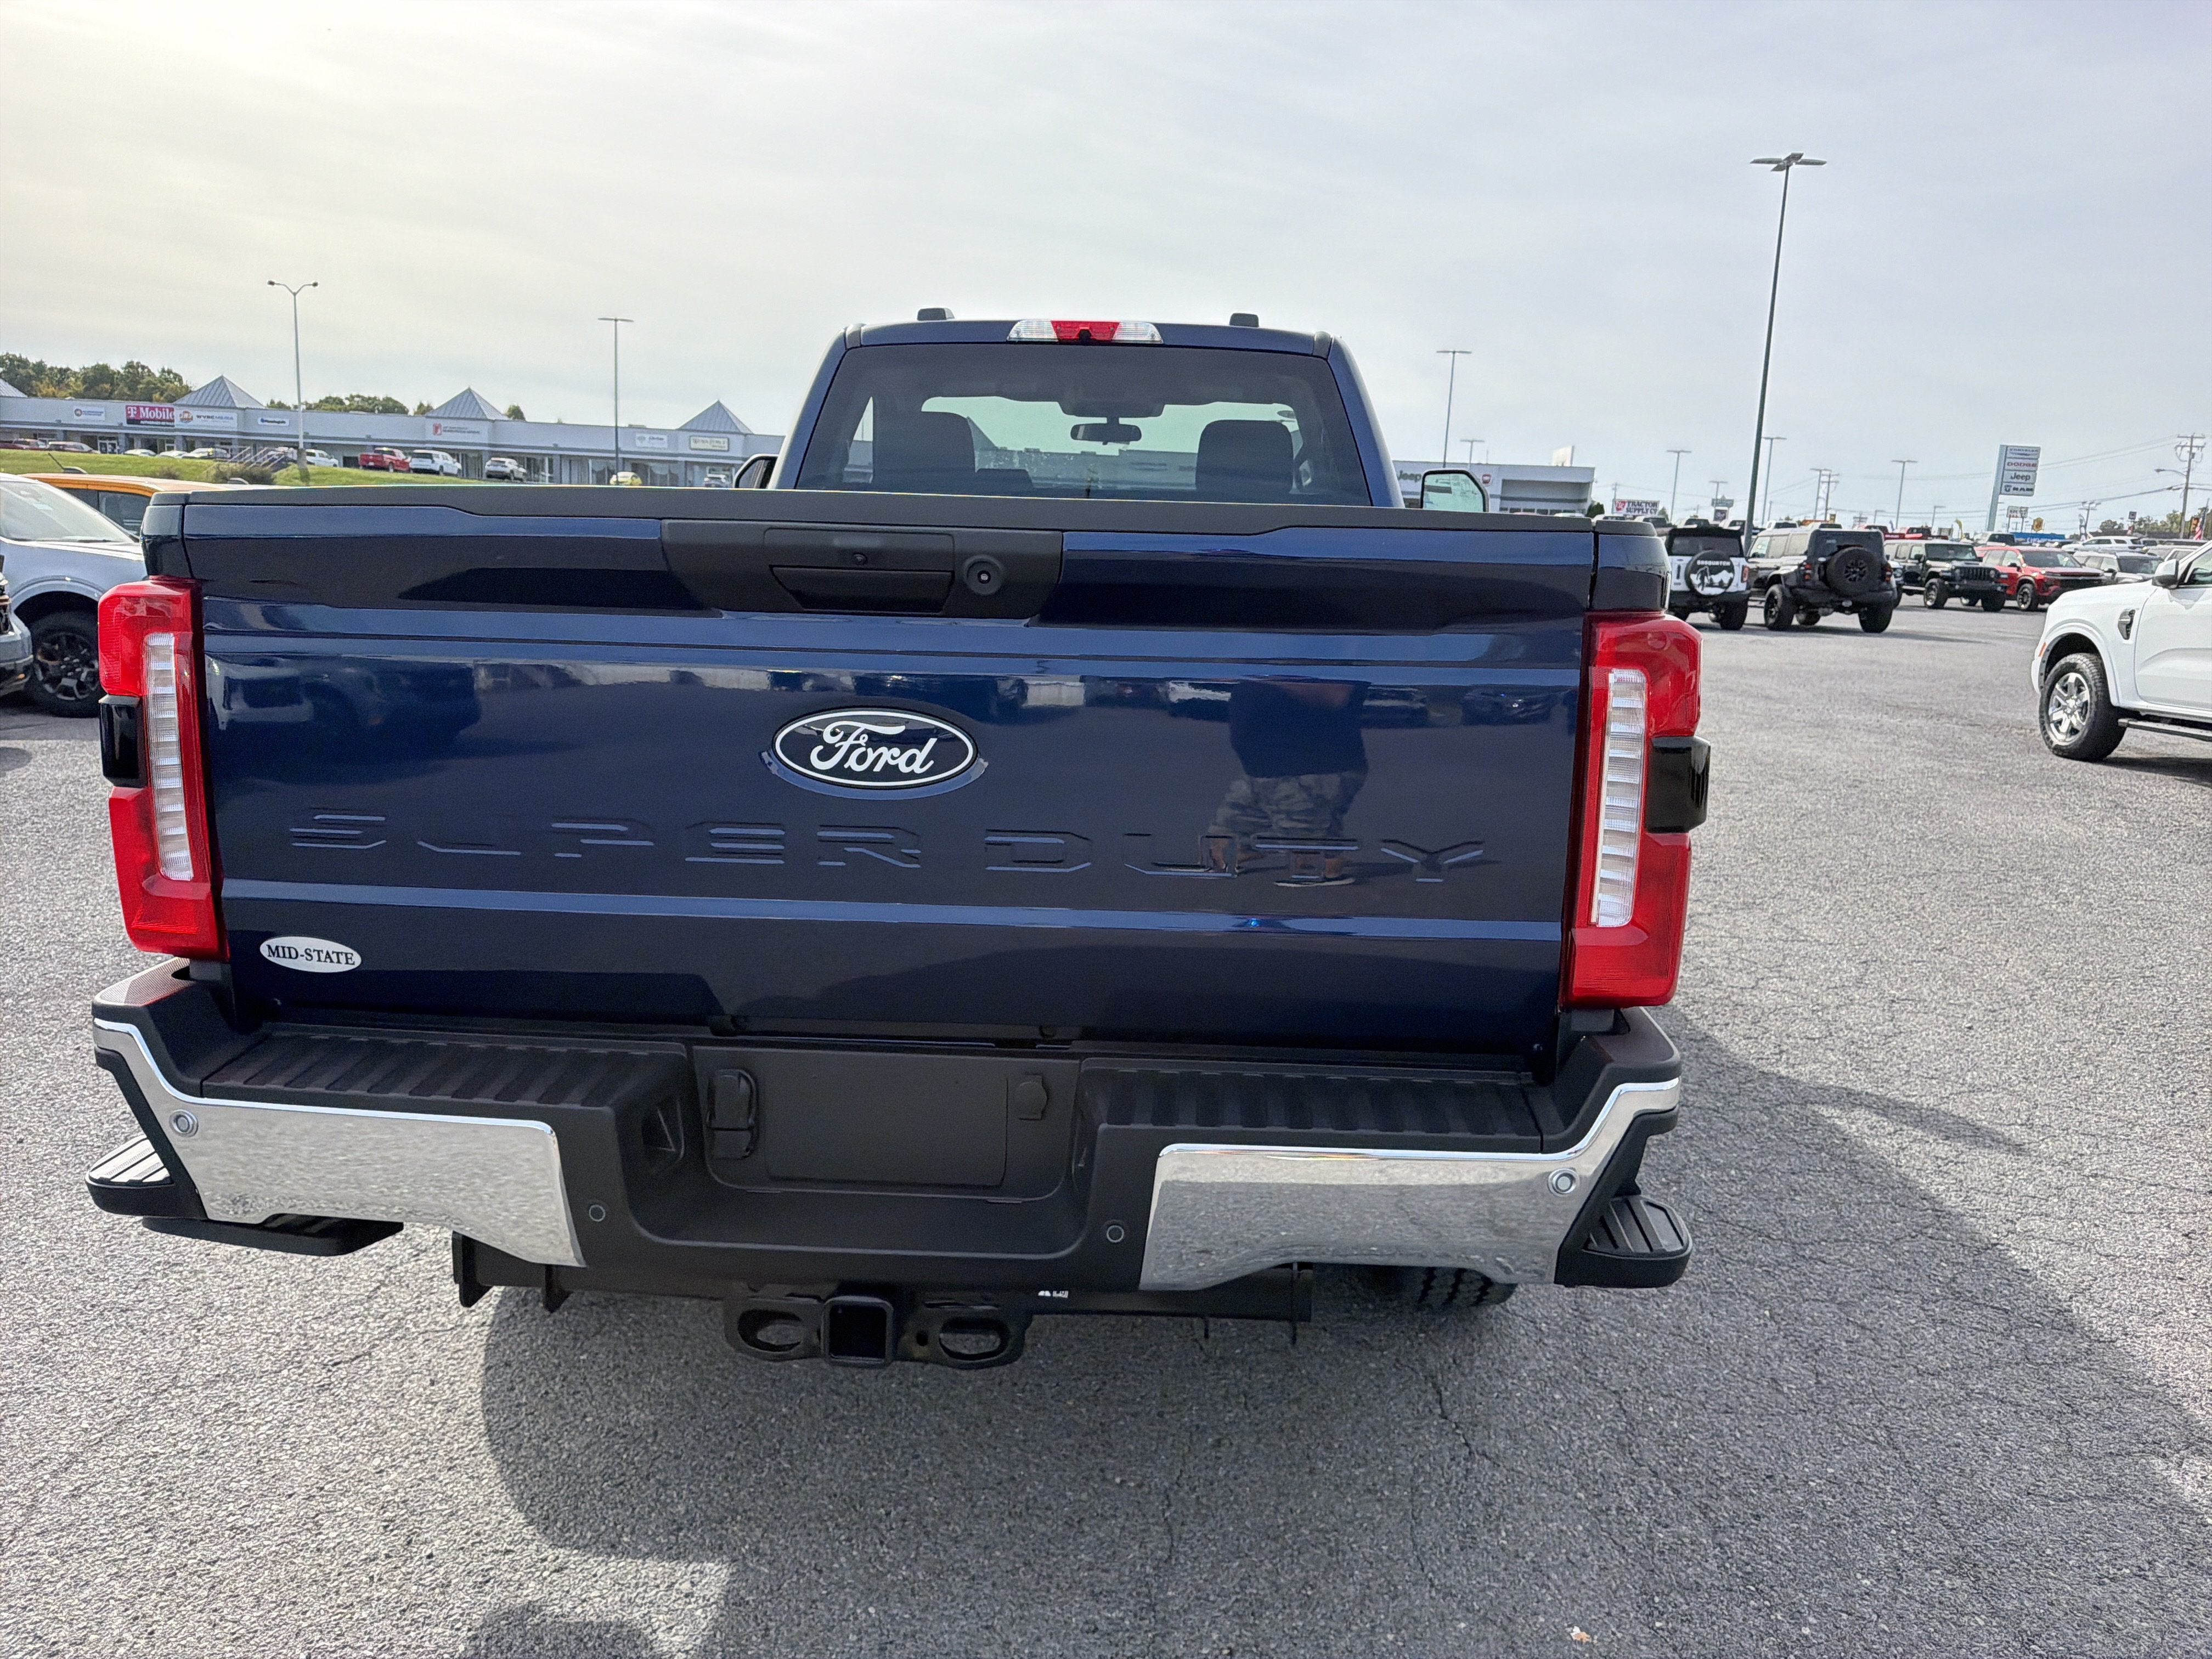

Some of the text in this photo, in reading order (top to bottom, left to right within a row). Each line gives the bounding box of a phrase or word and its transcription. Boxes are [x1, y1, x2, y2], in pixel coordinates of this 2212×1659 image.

[1399, 470, 1421, 483] Jeep
[2010, 472, 2031, 481] Jeep
[810, 720, 938, 774] Ford
[289, 807, 1485, 883] SUPER DUTY
[266, 944, 356, 966] MID-STATE
